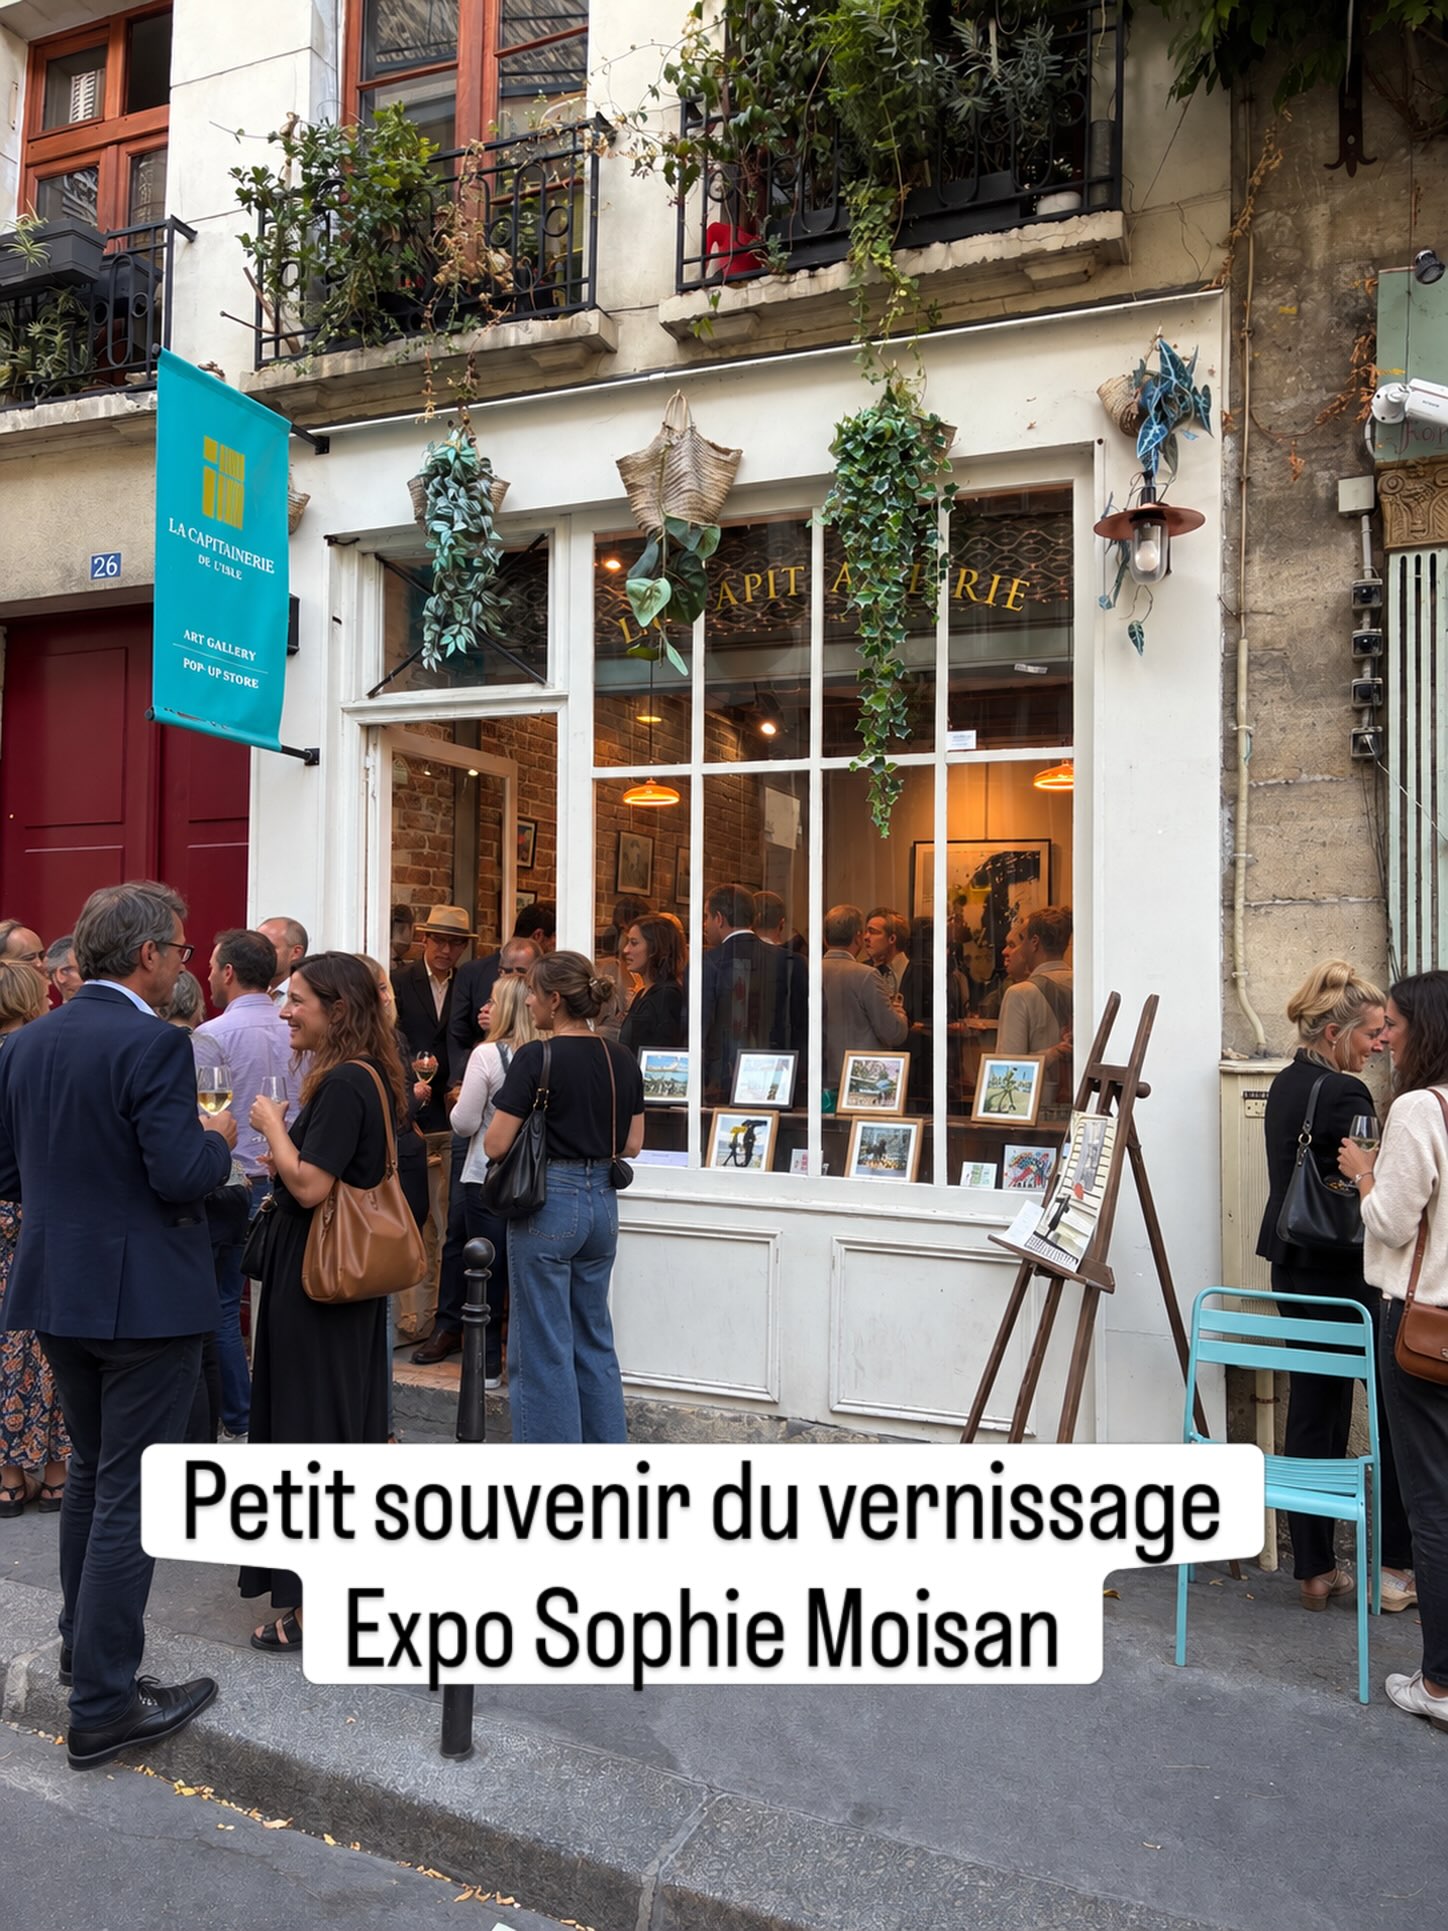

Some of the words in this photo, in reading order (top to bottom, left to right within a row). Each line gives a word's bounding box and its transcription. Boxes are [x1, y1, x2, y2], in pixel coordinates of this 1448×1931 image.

[168, 516, 187, 538] LA
[188, 527, 275, 574] CAPITAINERIE
[94, 555, 118, 578] 26
[198, 553, 211, 568] DE
[183, 629, 205, 645] ART
[206, 637, 257, 662] GALLERY
[223, 670, 260, 689] STORE
